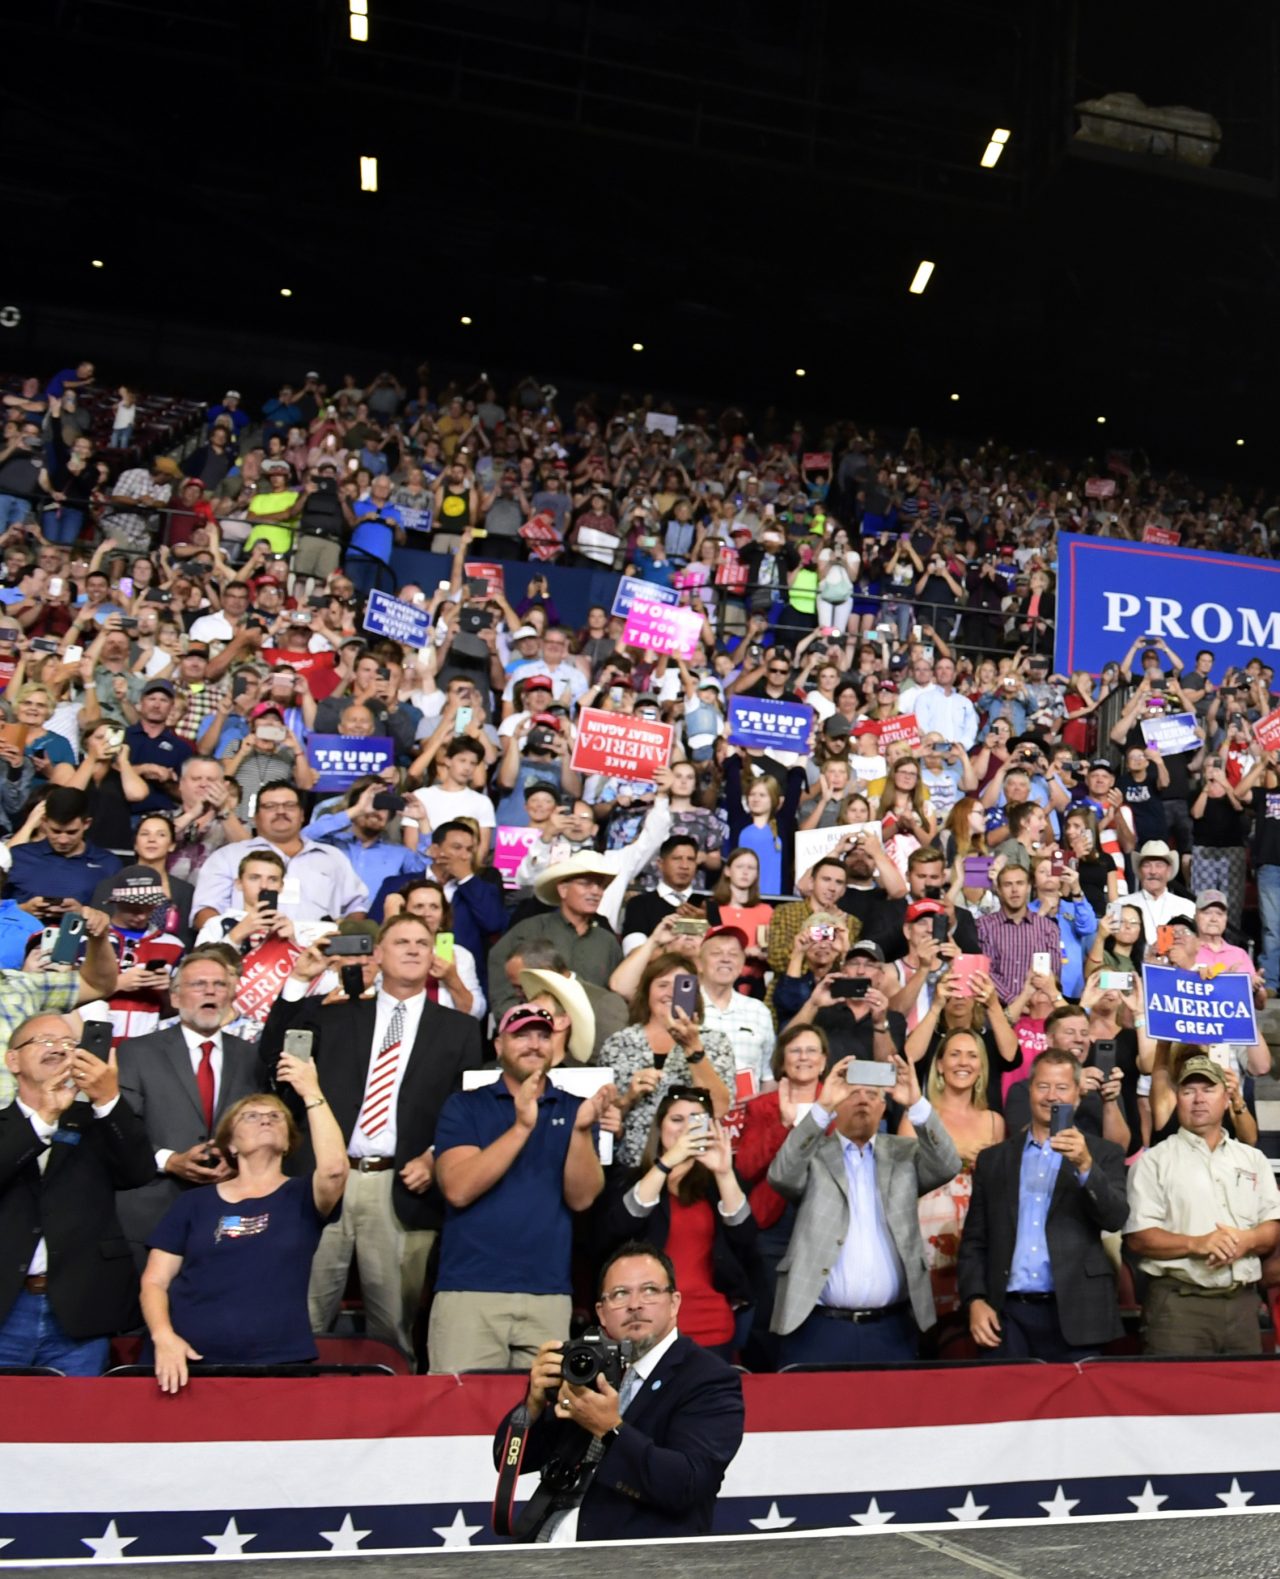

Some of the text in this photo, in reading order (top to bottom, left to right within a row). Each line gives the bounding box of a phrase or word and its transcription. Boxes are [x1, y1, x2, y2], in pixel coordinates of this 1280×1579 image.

[628, 628, 691, 653] TRUMP
[735, 709, 808, 728] TRUMP
[740, 720, 800, 736] PENCE
[586, 720, 665, 745] GREAT AGAIN
[314, 749, 388, 764] TRUMP
[579, 732, 668, 763] AMERICA
[321, 761, 381, 772] PENCE
[604, 755, 638, 771] MAKE
[1176, 978, 1215, 997] KEEP
[1148, 992, 1252, 1019] AMERICA
[1174, 1019, 1225, 1036] GREAT
[506, 1436, 522, 1466] EOS
